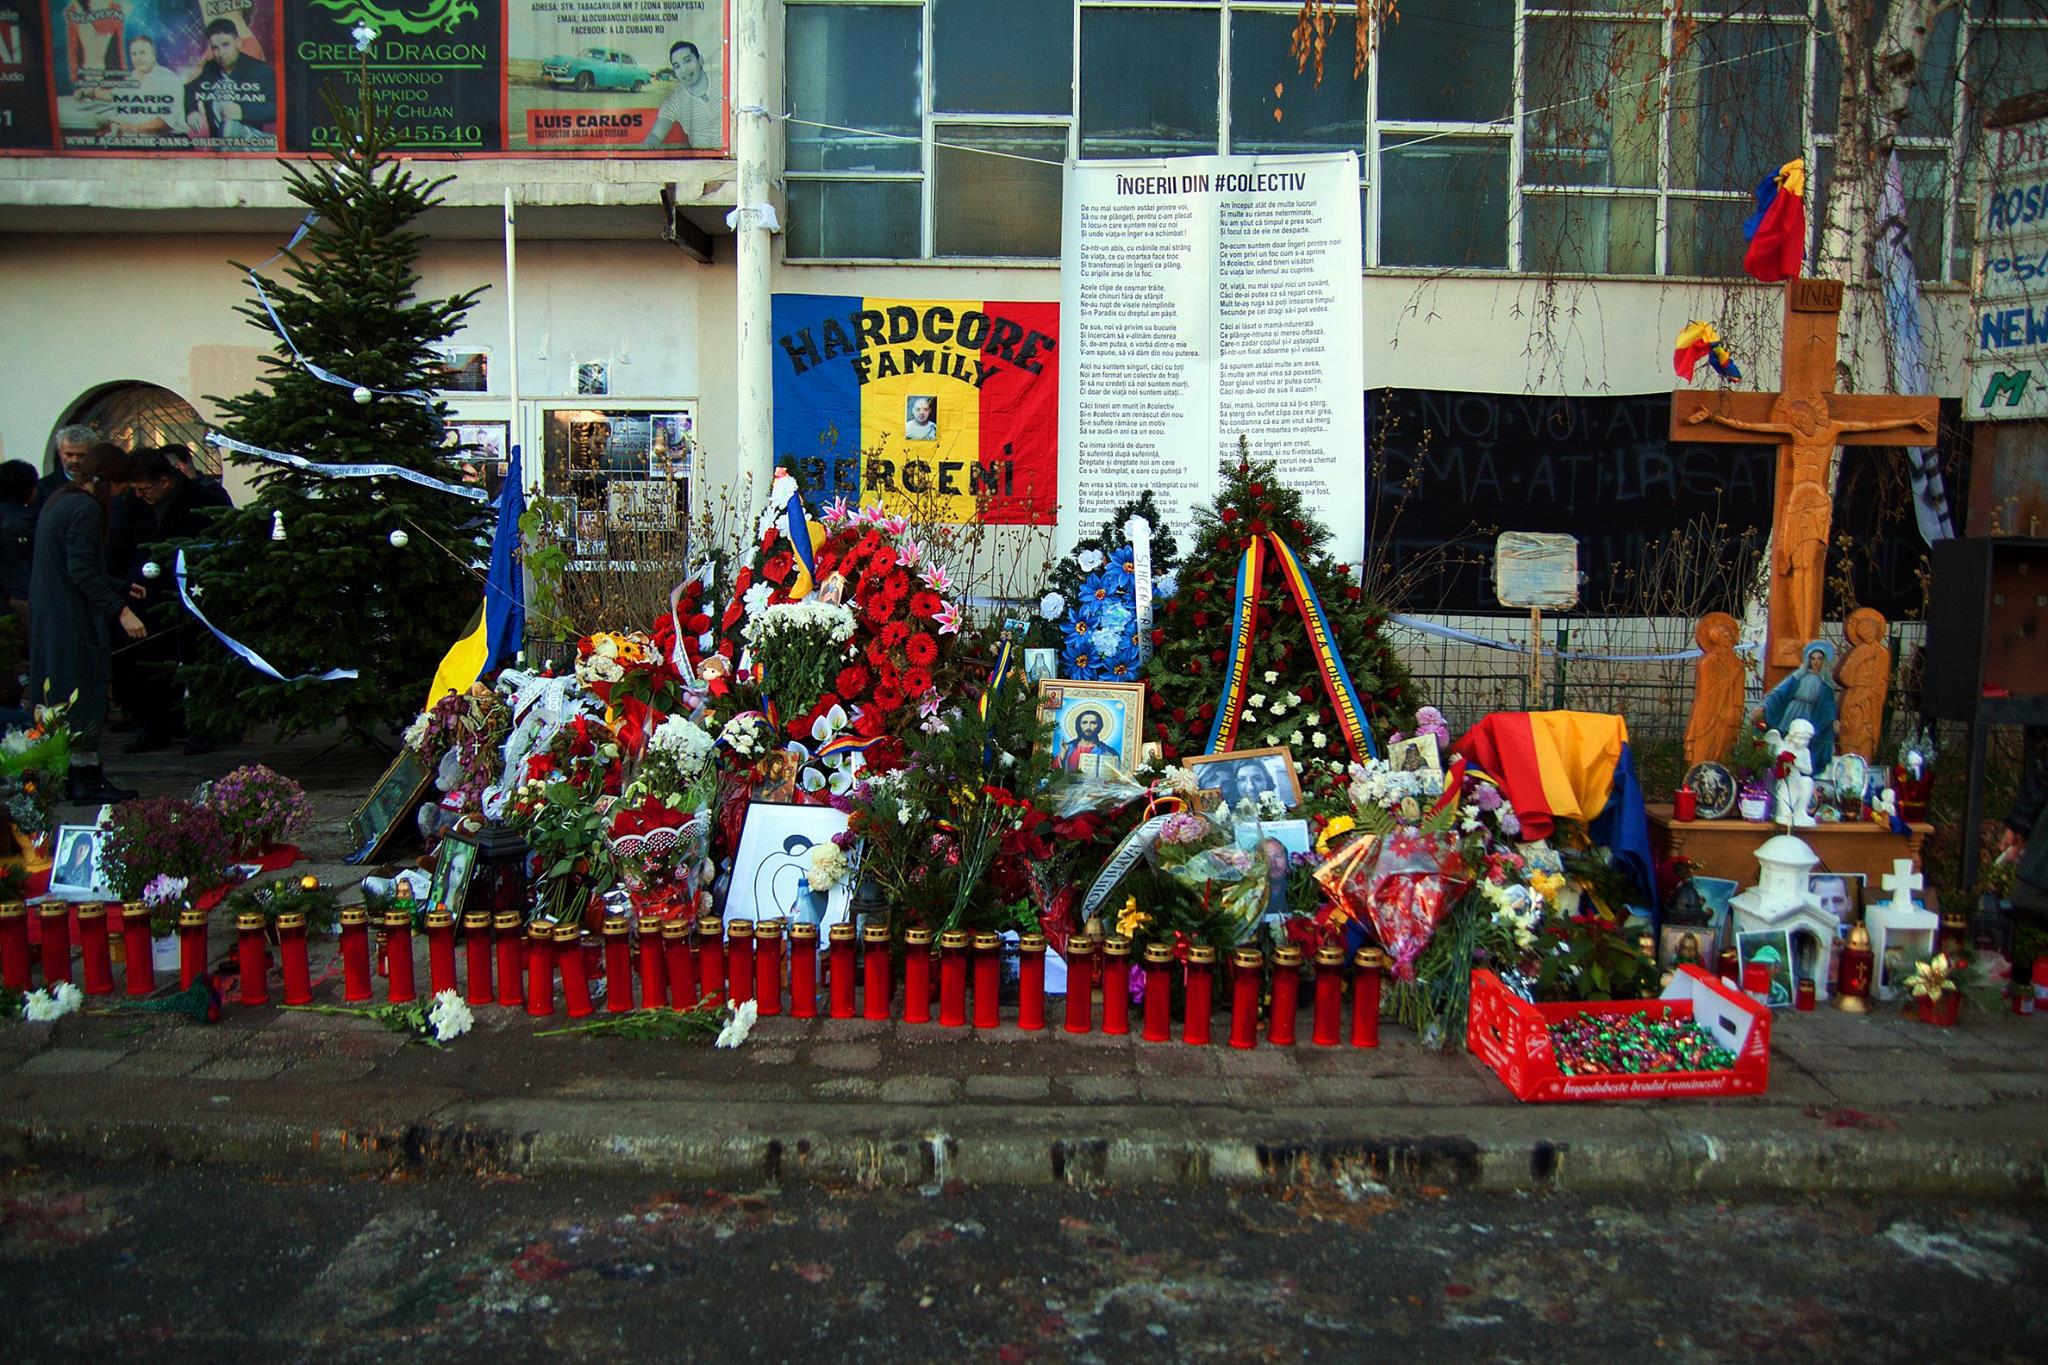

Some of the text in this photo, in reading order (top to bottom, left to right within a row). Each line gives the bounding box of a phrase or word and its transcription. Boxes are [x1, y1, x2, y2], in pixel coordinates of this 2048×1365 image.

[298, 41, 487, 61] GREEN DRAGON
[200, 82, 261, 91] CARLOS
[113, 95, 175, 103] MARIO
[116, 106, 172, 115] KIRLIS
[534, 114, 643, 128] LUIS CARLOS
[1116, 173, 1306, 195] ÎNGERII DIN #COLECTIV
[779, 306, 1056, 377] HARDCORE
